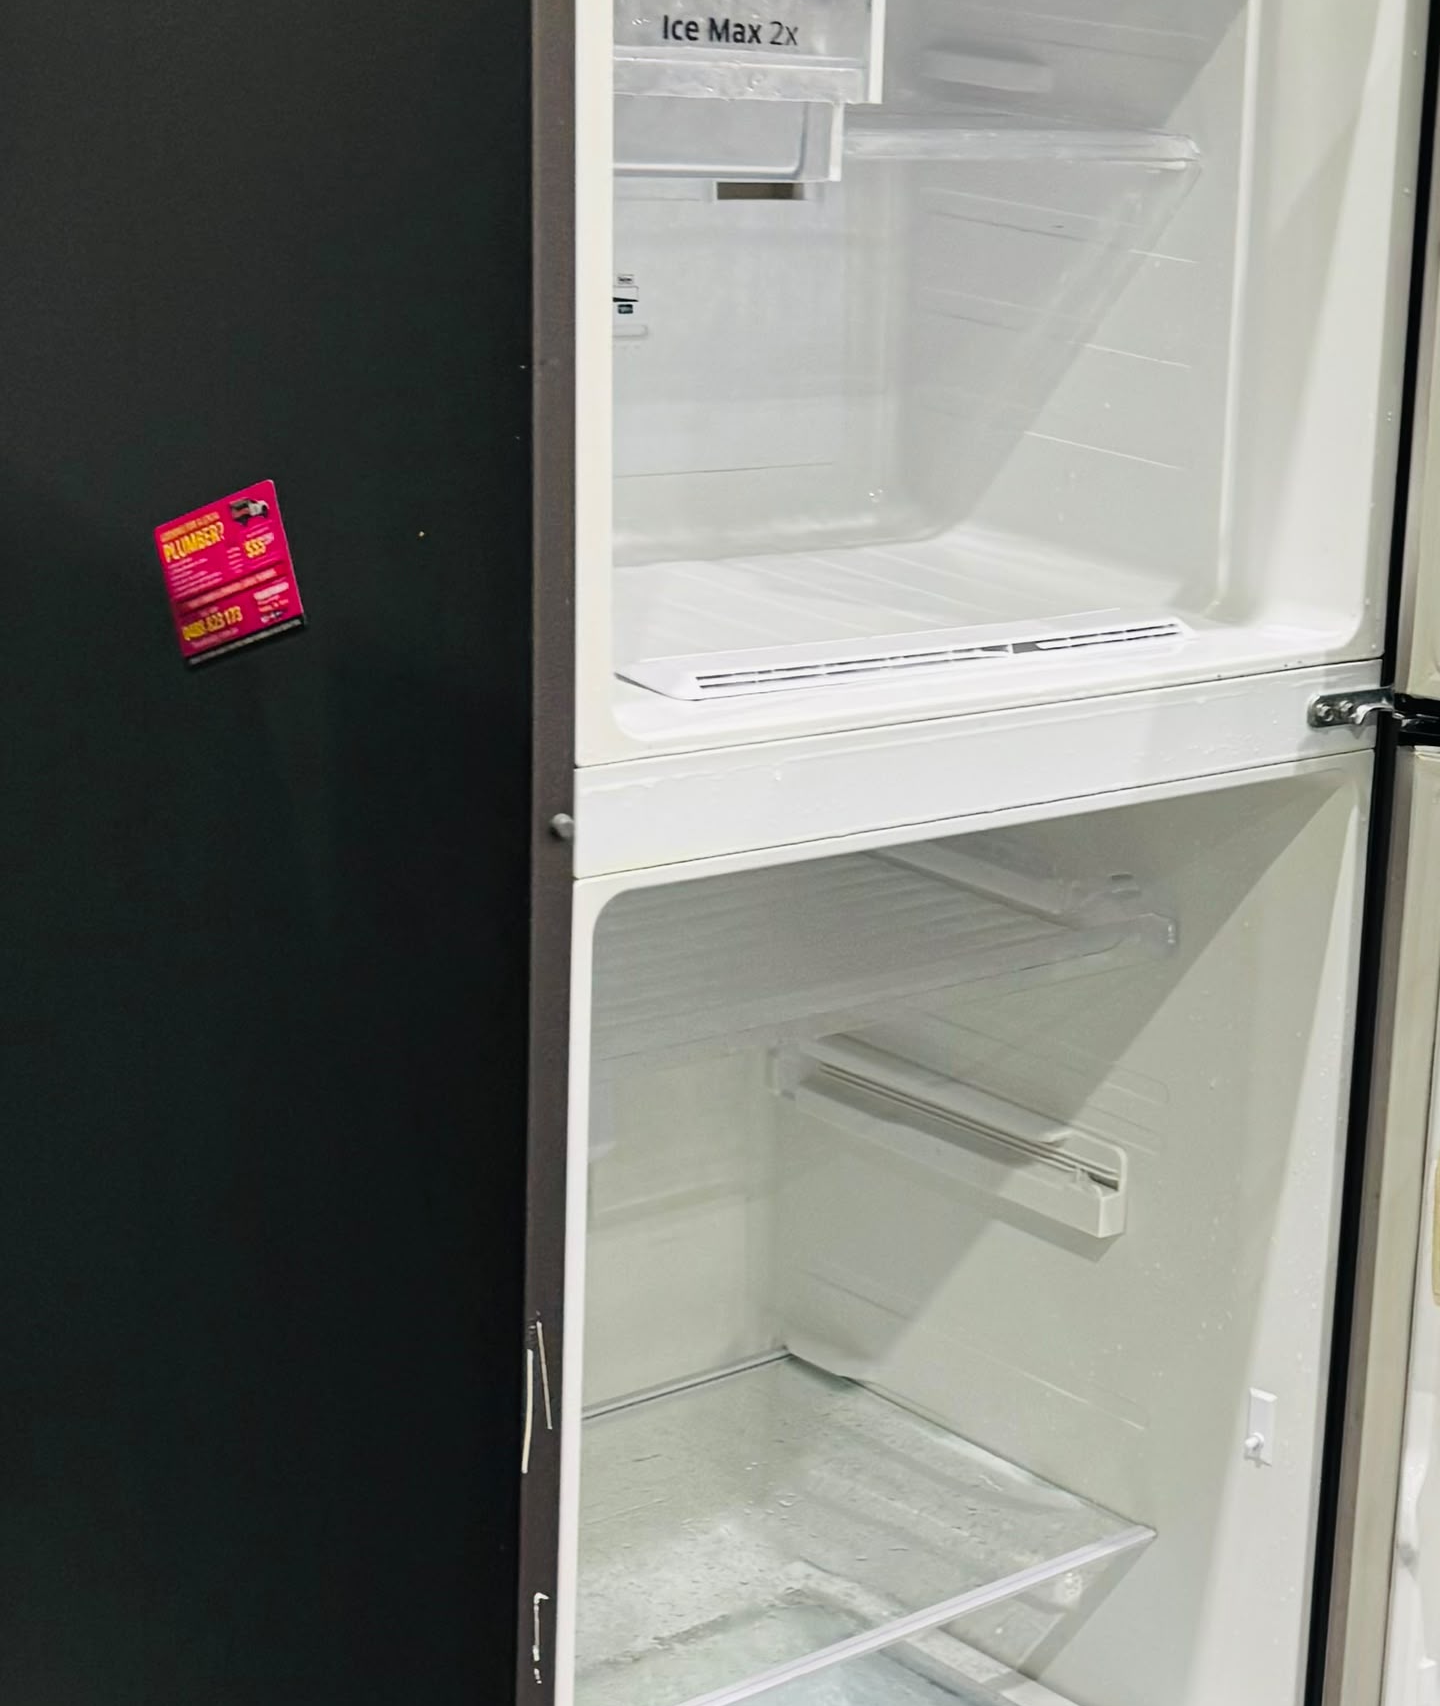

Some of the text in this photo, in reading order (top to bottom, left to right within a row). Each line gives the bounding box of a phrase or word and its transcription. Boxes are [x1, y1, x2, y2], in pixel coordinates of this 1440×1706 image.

[664, 15, 798, 46] Ice Max 2x
[162, 521, 225, 564] PLUMBER?
